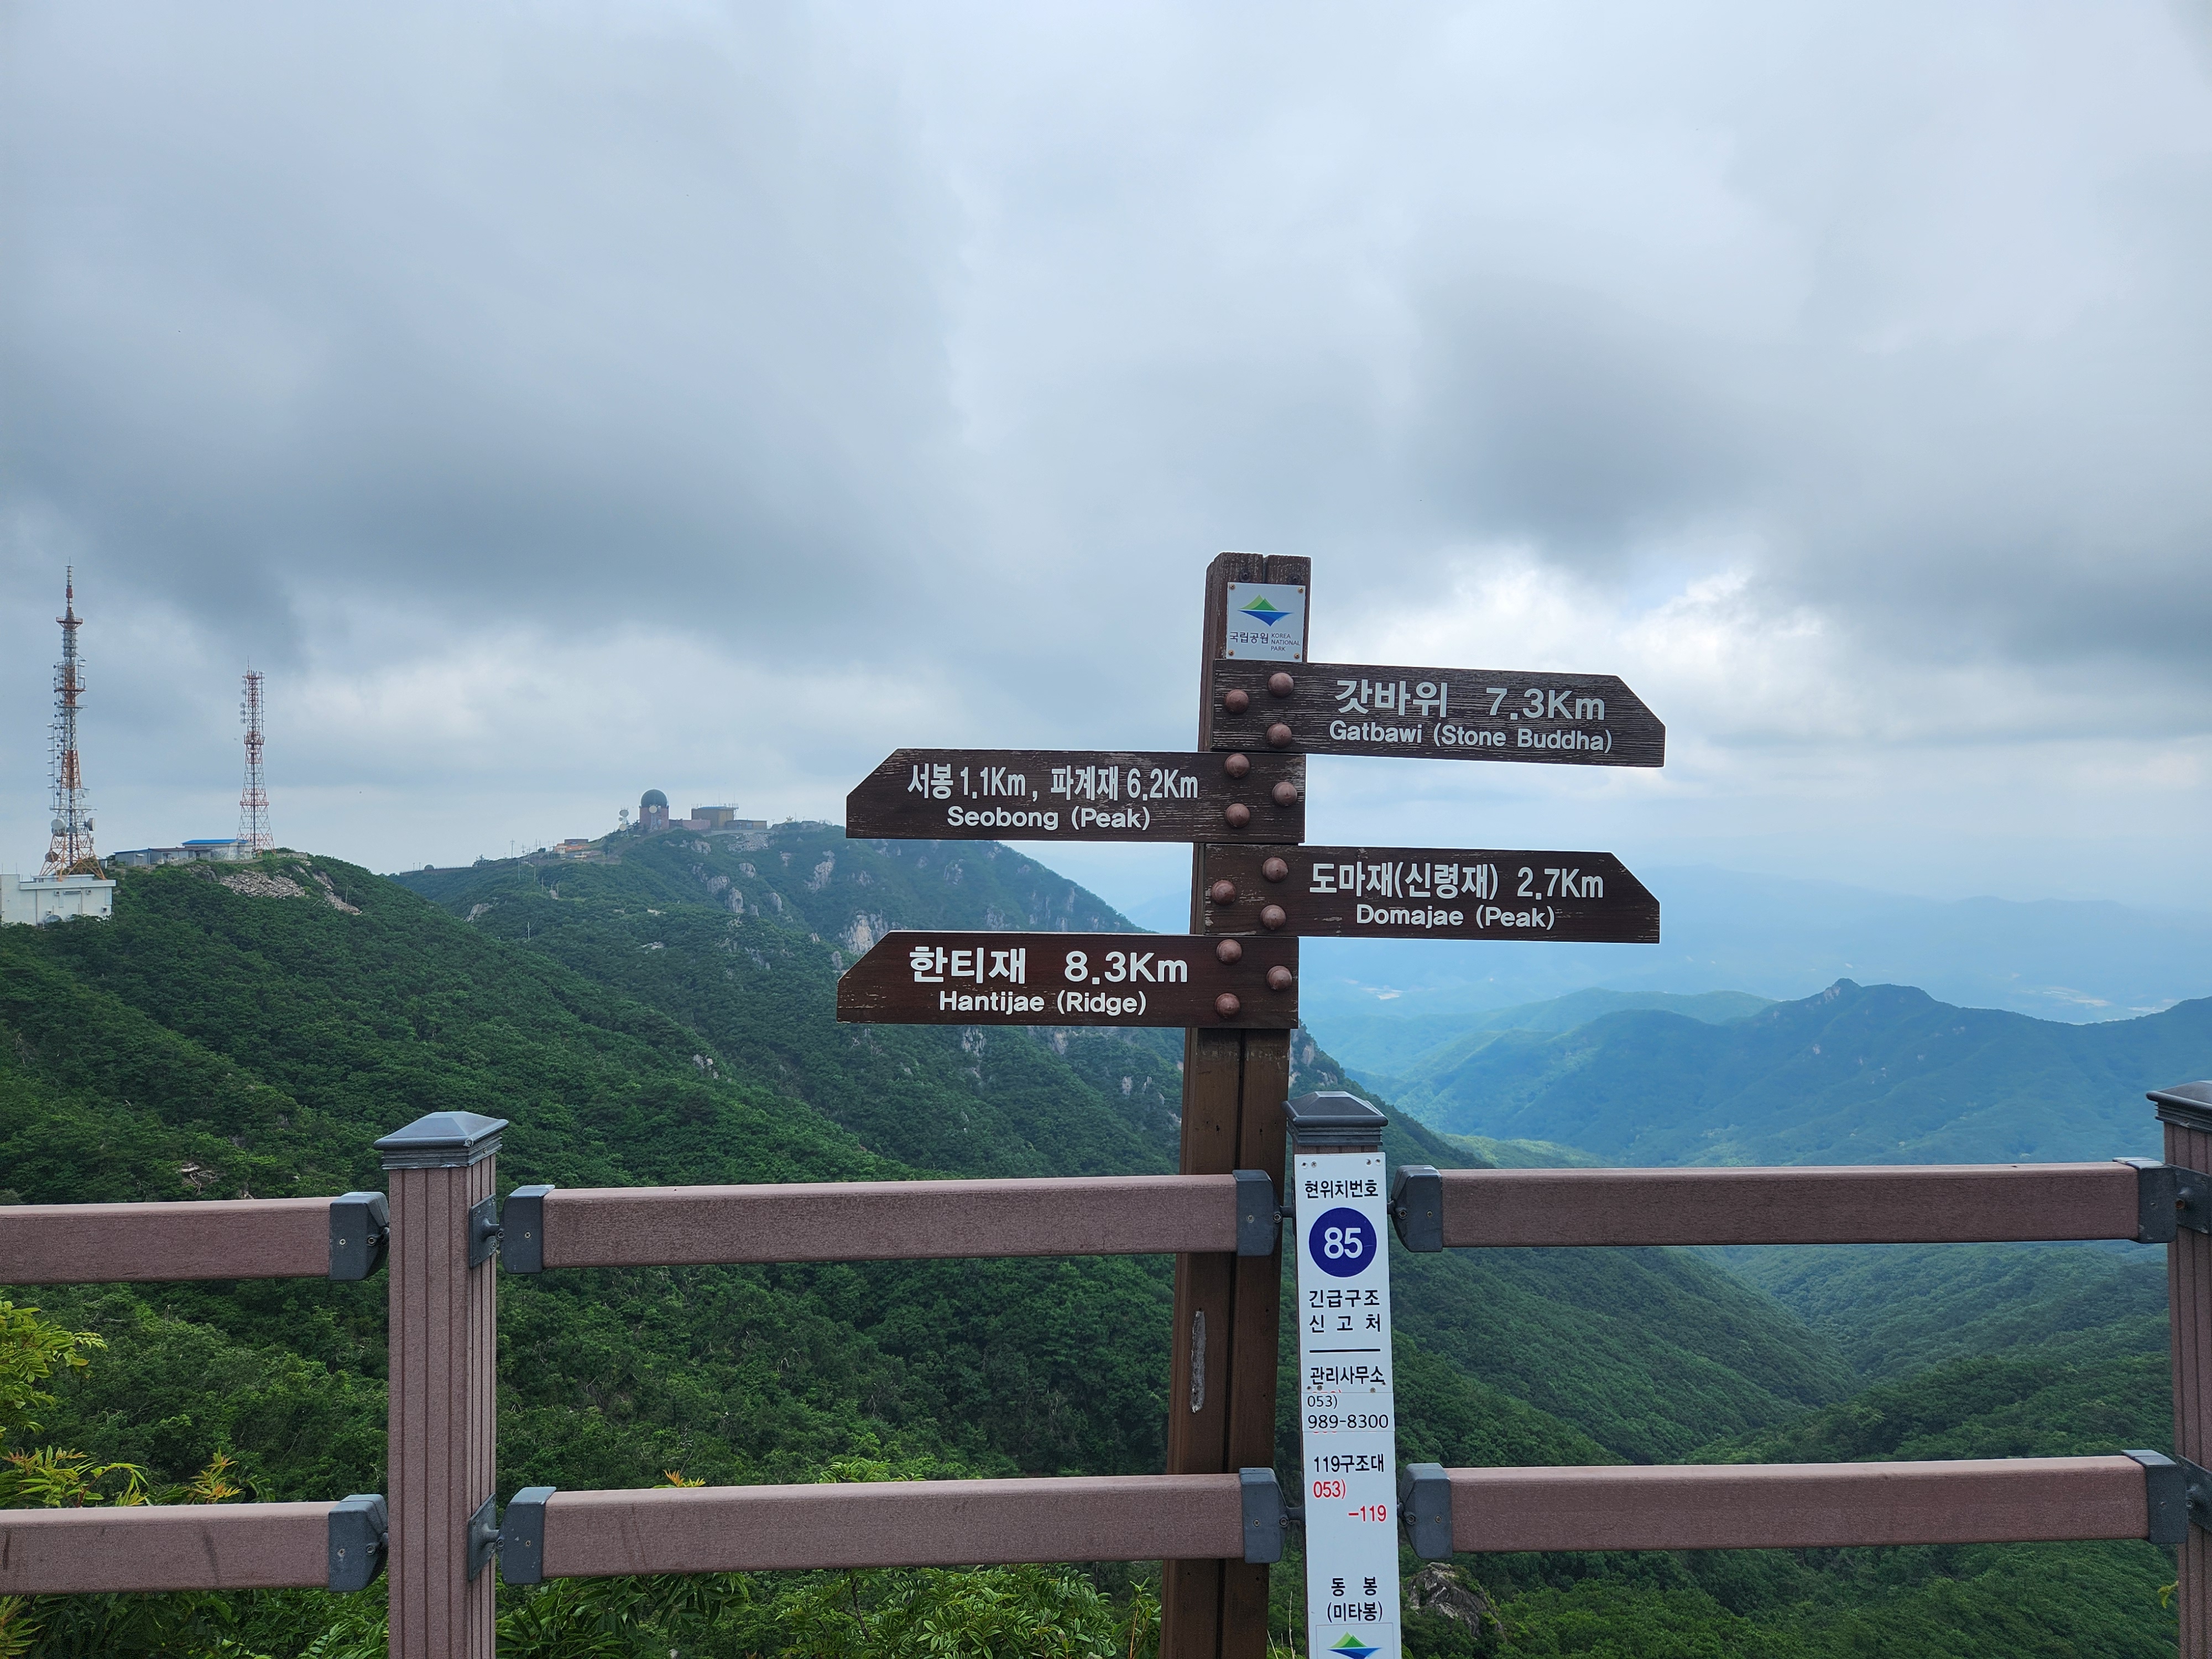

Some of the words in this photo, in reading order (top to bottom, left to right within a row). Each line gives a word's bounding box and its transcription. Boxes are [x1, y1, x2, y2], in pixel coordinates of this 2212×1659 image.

[1229, 632, 1269, 644] 국립공원
[1335, 679, 1448, 718] 갓바위
[1486, 687, 1604, 720] 7.3Km
[1329, 720, 1422, 743] Gatbawi
[1433, 723, 1506, 747] (Stone
[1517, 728, 1613, 754] Buddha)
[907, 763, 954, 800] 서봉
[960, 766, 1039, 802] 1.1Km,
[1051, 765, 1119, 801] 파계재
[1126, 768, 1199, 801] 6.2Km
[947, 806, 1059, 830] Seobong
[1071, 806, 1150, 830] (Peak)
[1309, 861, 1499, 900] 도마재(신령재)
[1516, 867, 1604, 900] 2.7Km
[1356, 904, 1464, 929] Domajae
[1475, 905, 1555, 930] (Peak)
[909, 946, 1026, 984] 한티재
[1064, 951, 1188, 985] 8.3Km
[940, 990, 1045, 1014] Hantijae
[1057, 990, 1146, 1016] (Ridge)
[1305, 1180, 1379, 1199] 현위치번호
[1324, 1227, 1363, 1259] 85
[1308, 1289, 1380, 1308] 긴급구조
[1310, 1365, 1385, 1385] 관리사무소
[1307, 1395, 1338, 1410] 053)
[1307, 1414, 1389, 1429] 989-8300
[1313, 1453, 1384, 1473] 119구조대
[1313, 1479, 1346, 1500] 053)
[1348, 1504, 1387, 1522] -119
[1327, 1601, 1383, 1623] (미타봉)
